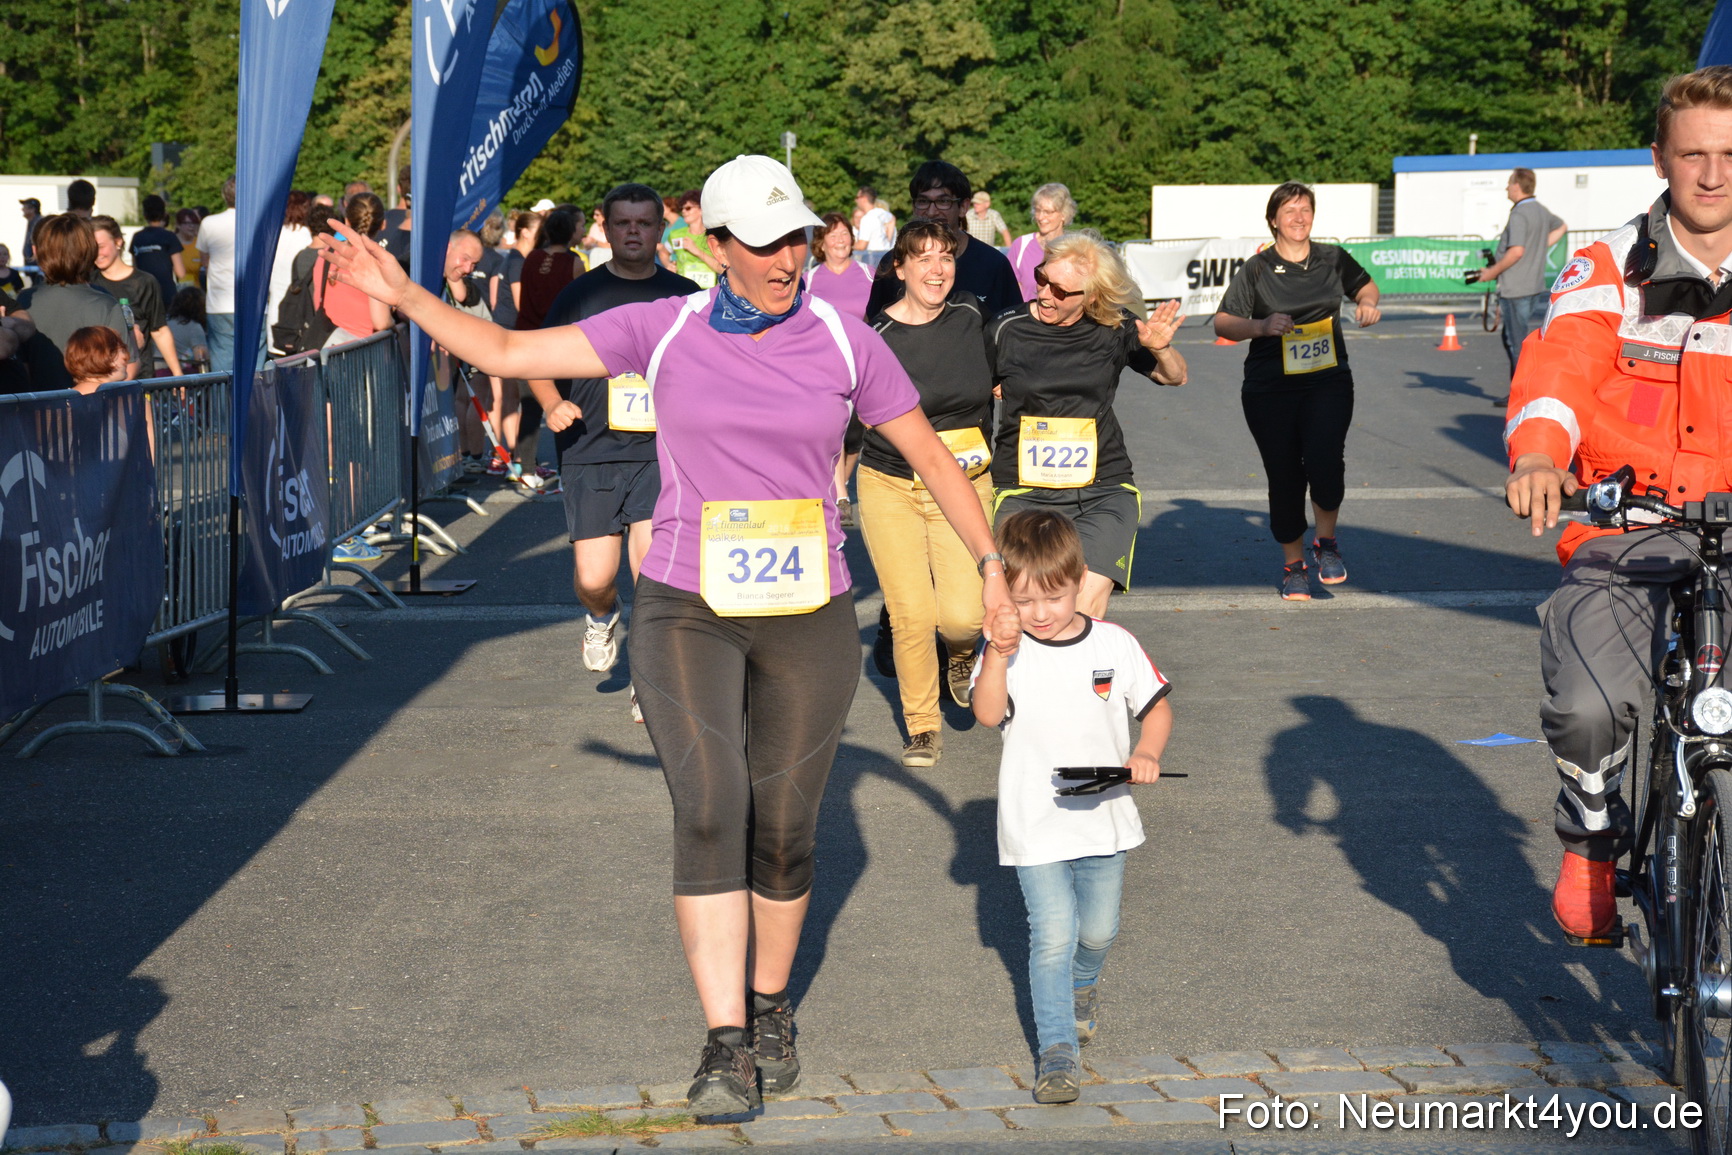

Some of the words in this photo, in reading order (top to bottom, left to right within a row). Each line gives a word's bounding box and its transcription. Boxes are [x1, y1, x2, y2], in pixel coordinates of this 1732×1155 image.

[512, 110, 535, 145] Druck
[547, 58, 574, 102] Medien
[766, 195, 790, 206] adidas
[1371, 249, 1470, 266] GESUNDHEIT
[1290, 339, 1330, 359] 1258
[1027, 445, 1089, 468] 1222
[720, 519, 766, 530] firmenlauf
[18, 517, 111, 613] Fischer
[727, 545, 804, 584] 324
[736, 592, 764, 600] Bianca
[765, 591, 795, 600] Segerer
[29, 599, 104, 661] AUTOMOBILE
